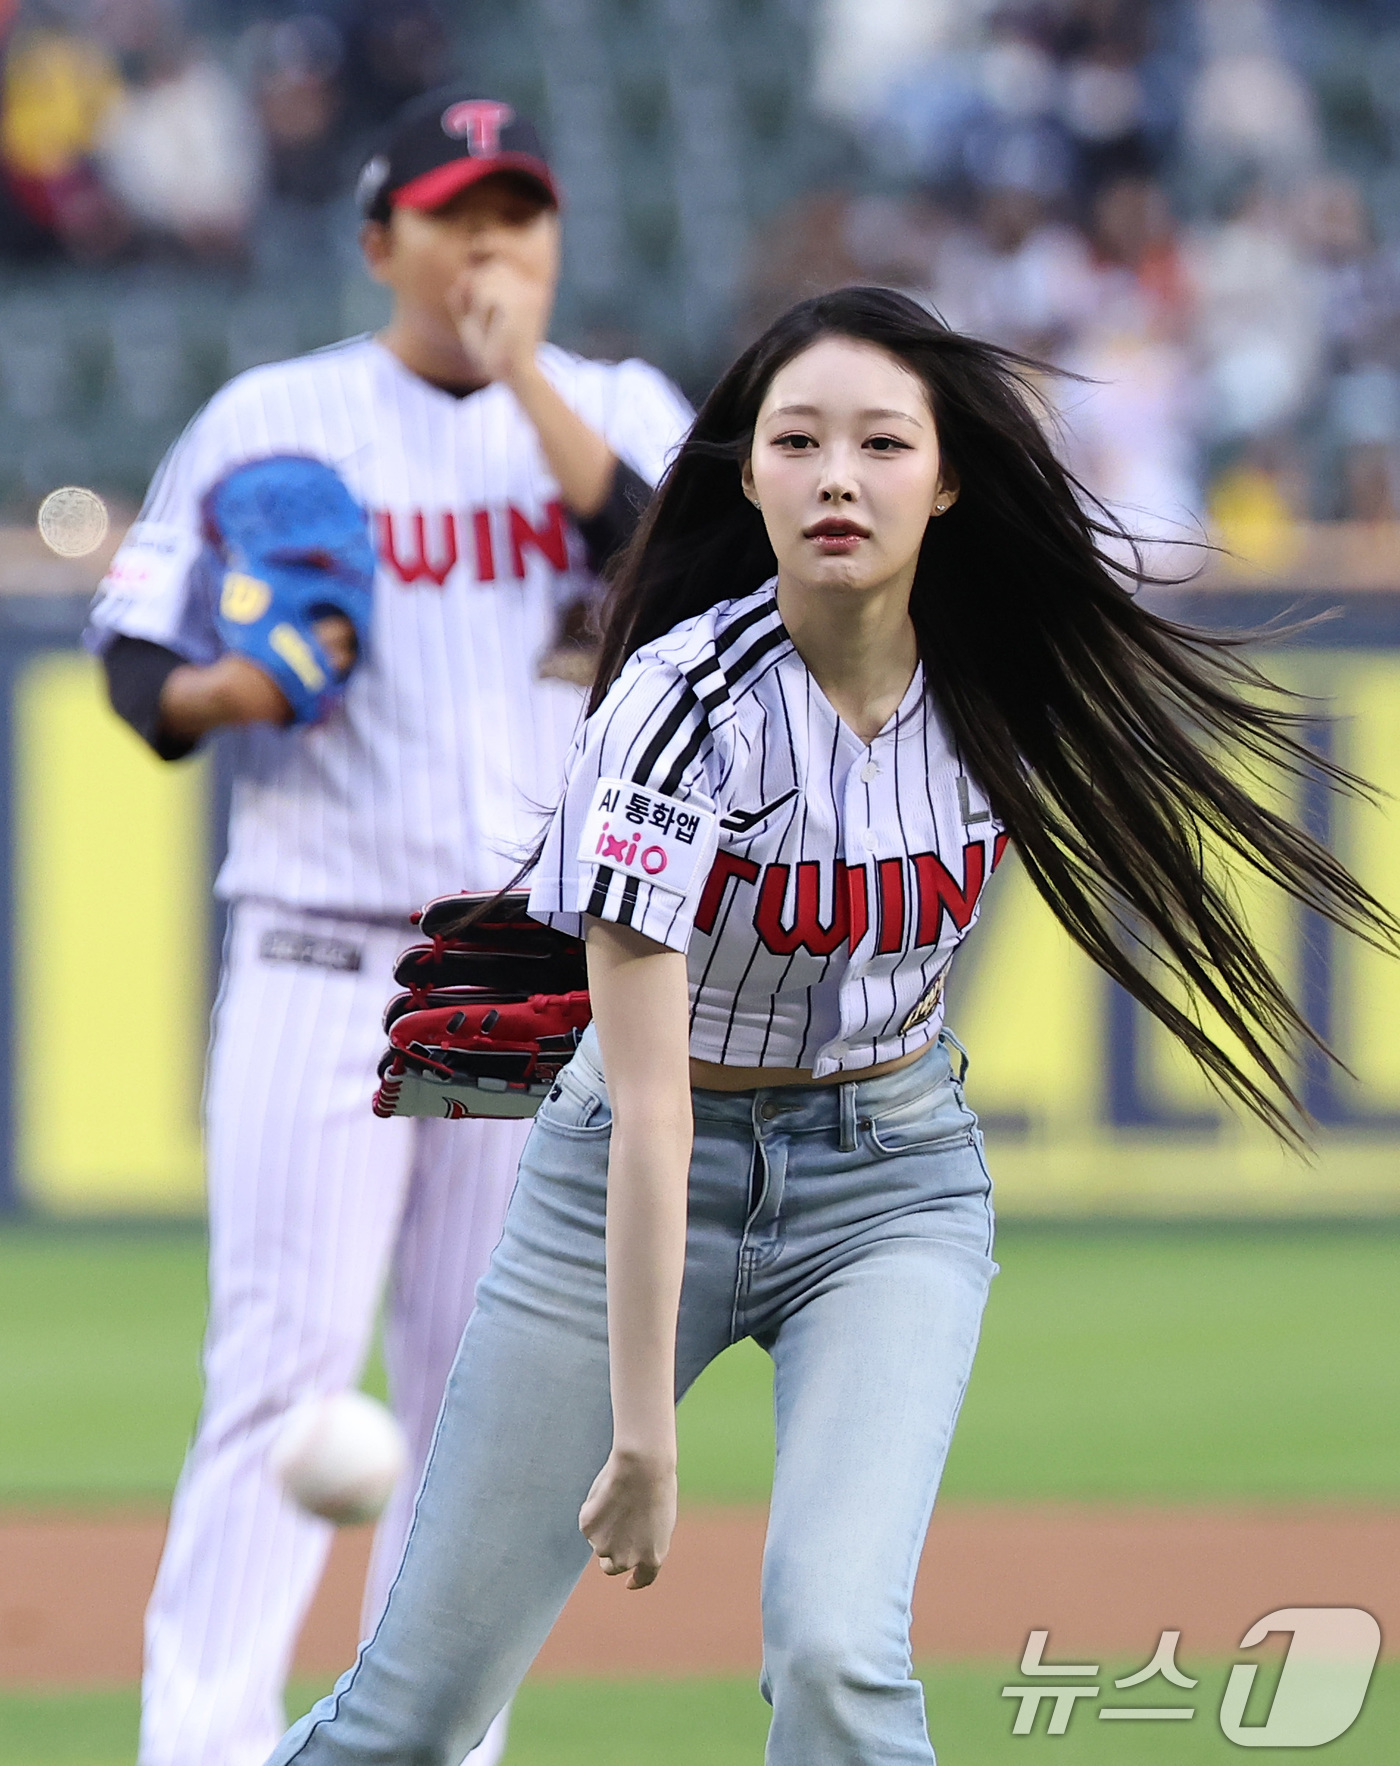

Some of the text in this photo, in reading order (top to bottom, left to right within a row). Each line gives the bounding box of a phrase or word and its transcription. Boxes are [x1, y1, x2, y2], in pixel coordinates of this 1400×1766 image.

[374, 498, 568, 586] WIN
[598, 788, 700, 845] AI 통화앱
[956, 776, 990, 826] L
[595, 821, 668, 875] ixio
[693, 834, 1010, 956] TWIN
